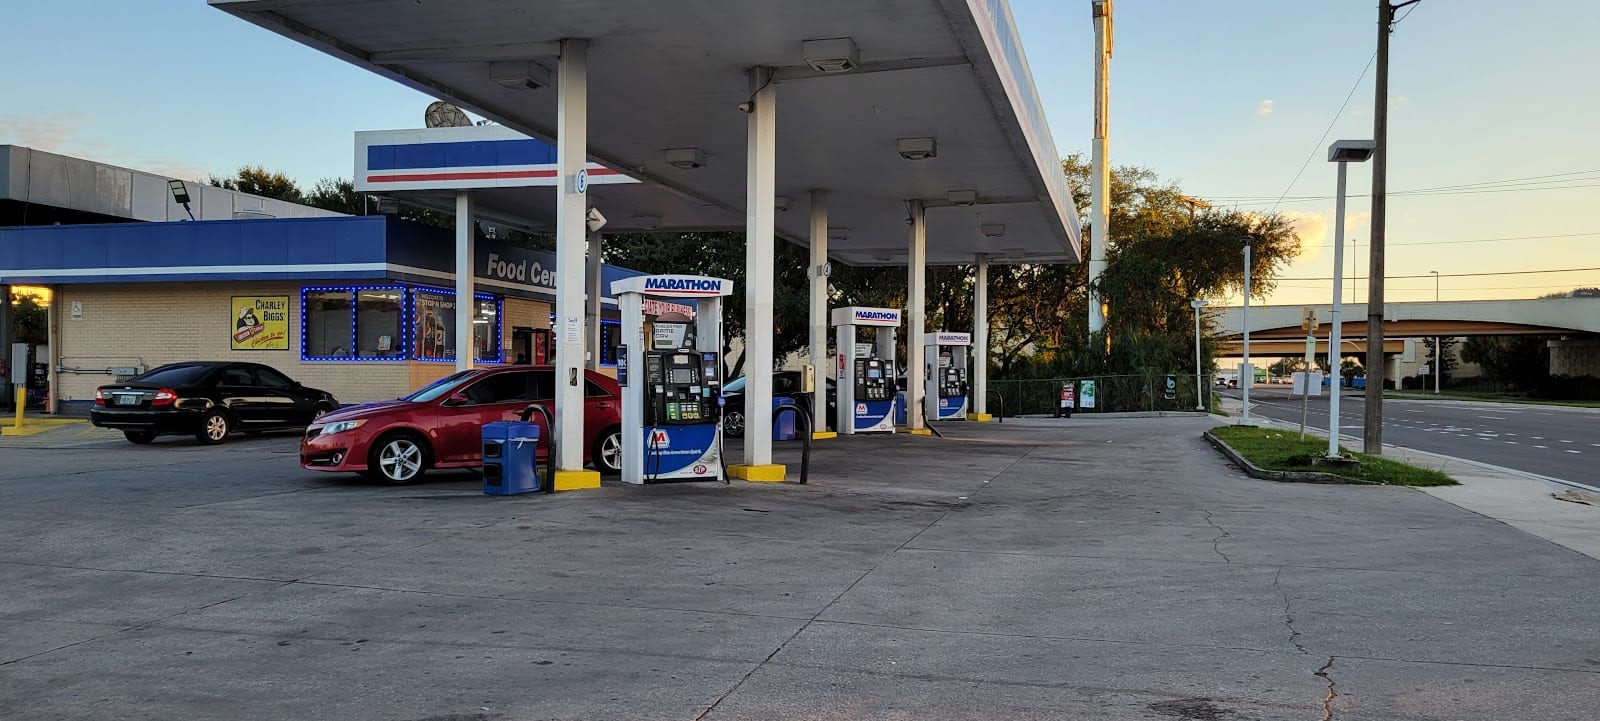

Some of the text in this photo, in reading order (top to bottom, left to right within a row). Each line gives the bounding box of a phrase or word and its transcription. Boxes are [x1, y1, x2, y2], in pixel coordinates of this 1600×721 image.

[487, 253, 557, 287] Food Cen
[645, 278, 721, 290] MARATHON
[256, 300, 286, 310] CHARLEY
[264, 311, 286, 321] BIGGS'
[855, 311, 898, 320] MARATHON
